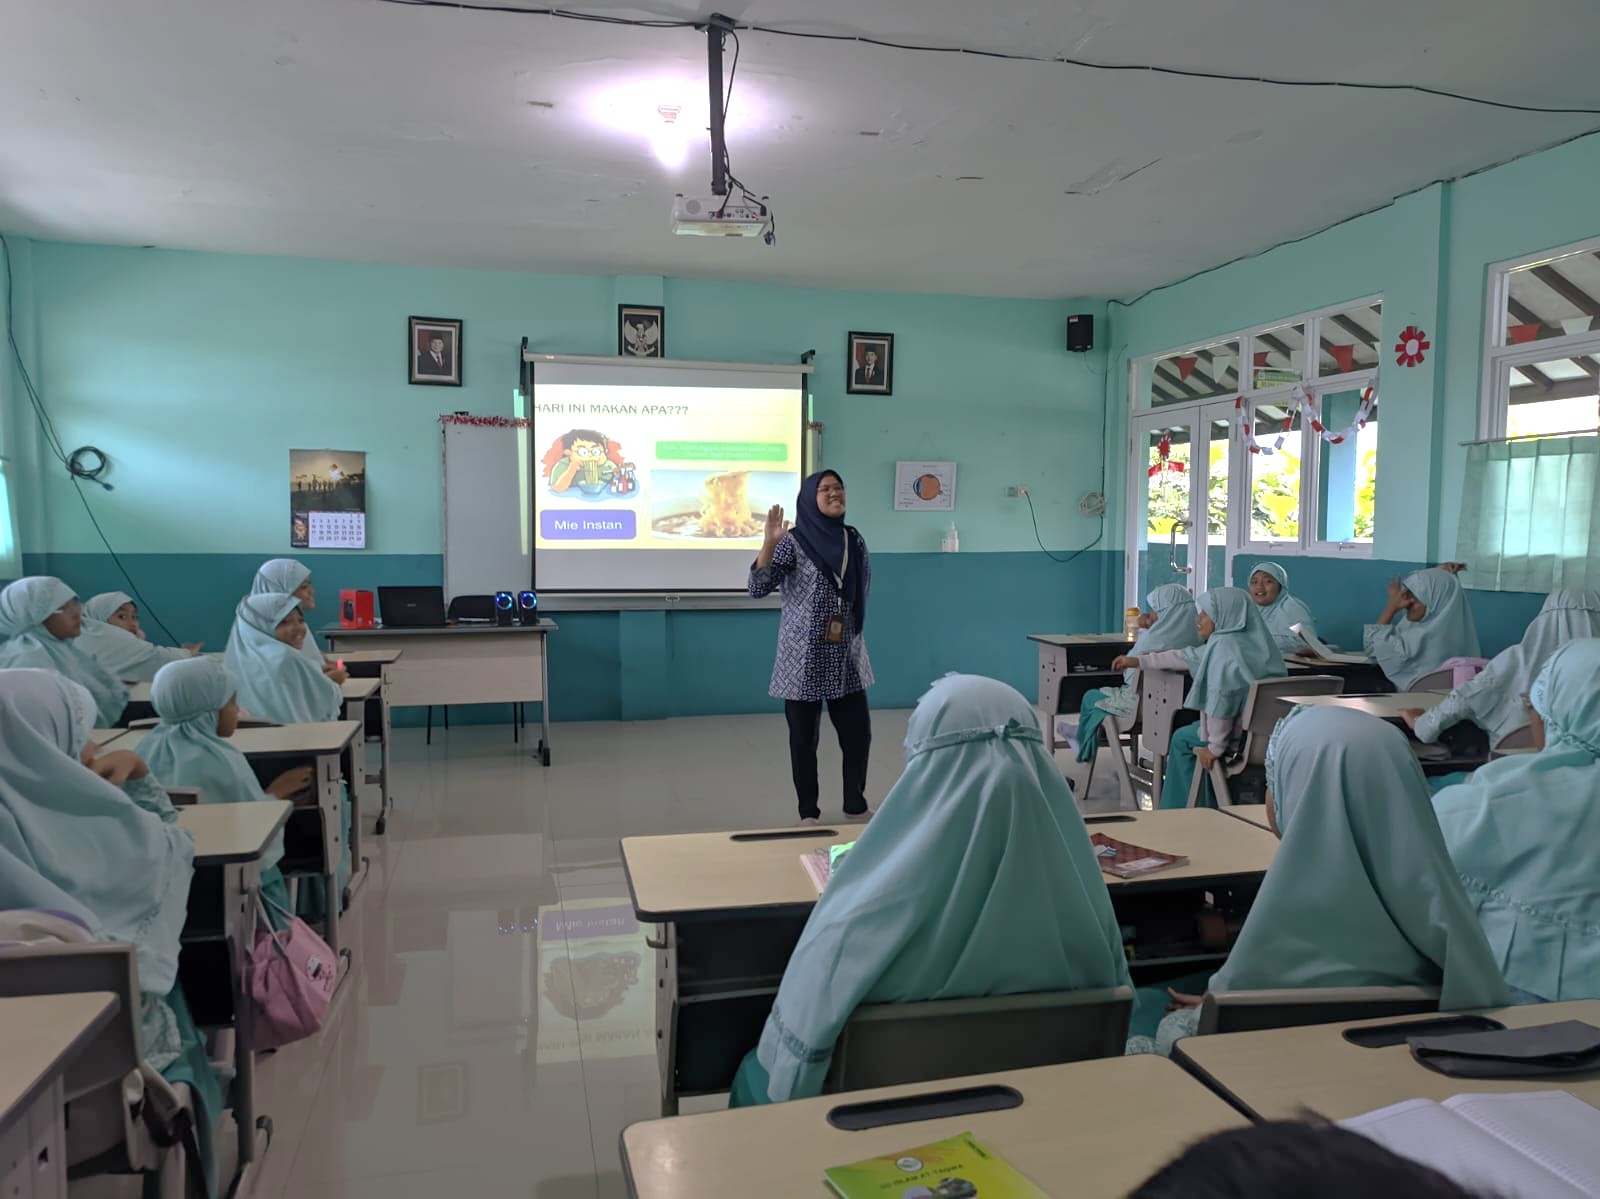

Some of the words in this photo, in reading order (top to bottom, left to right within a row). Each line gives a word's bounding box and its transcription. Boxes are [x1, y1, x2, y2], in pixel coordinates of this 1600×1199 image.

[568, 403, 586, 413] INI
[590, 404, 637, 414] MAKAN
[641, 404, 689, 415] APA???
[554, 519, 579, 530] Mie
[583, 519, 623, 530] Instan
